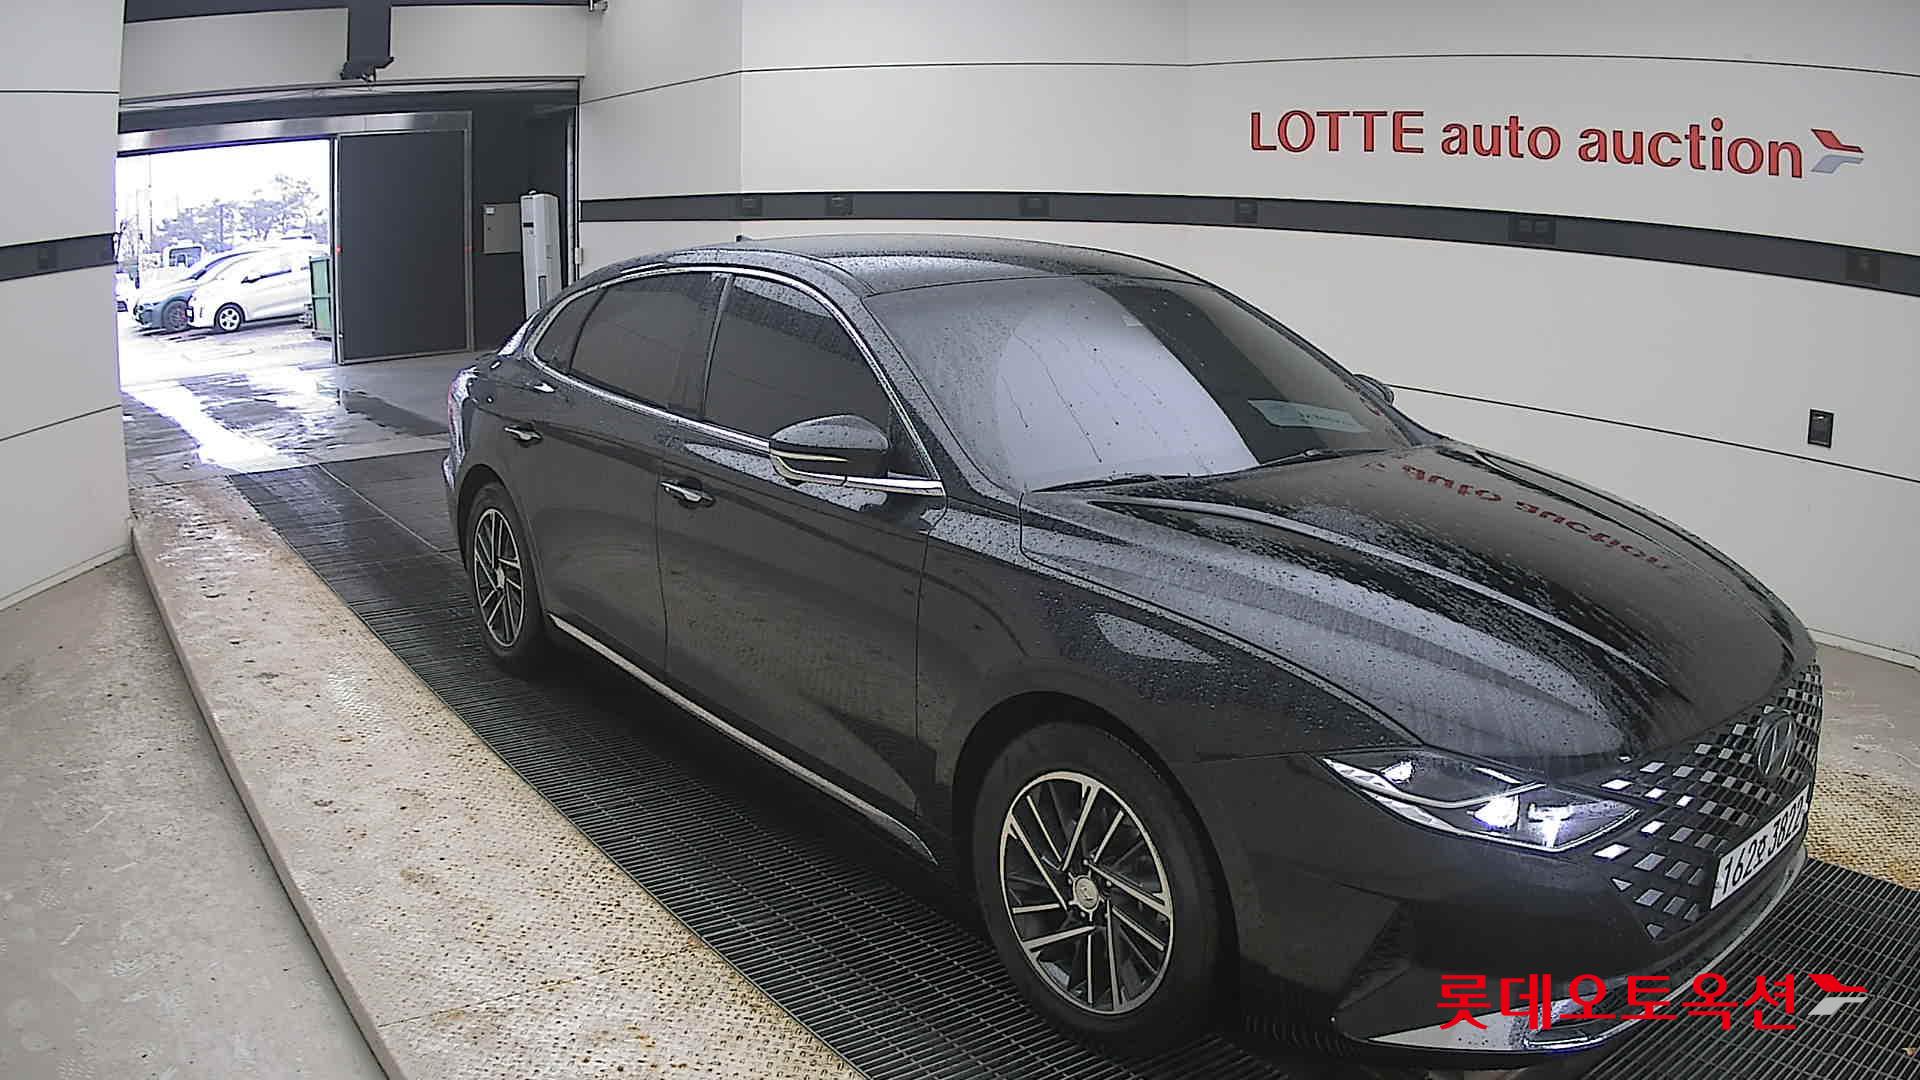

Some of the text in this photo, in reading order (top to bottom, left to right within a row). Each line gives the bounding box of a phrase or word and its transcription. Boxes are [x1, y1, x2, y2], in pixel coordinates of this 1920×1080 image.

[1250, 109, 1804, 179] LOTTE auto auction
